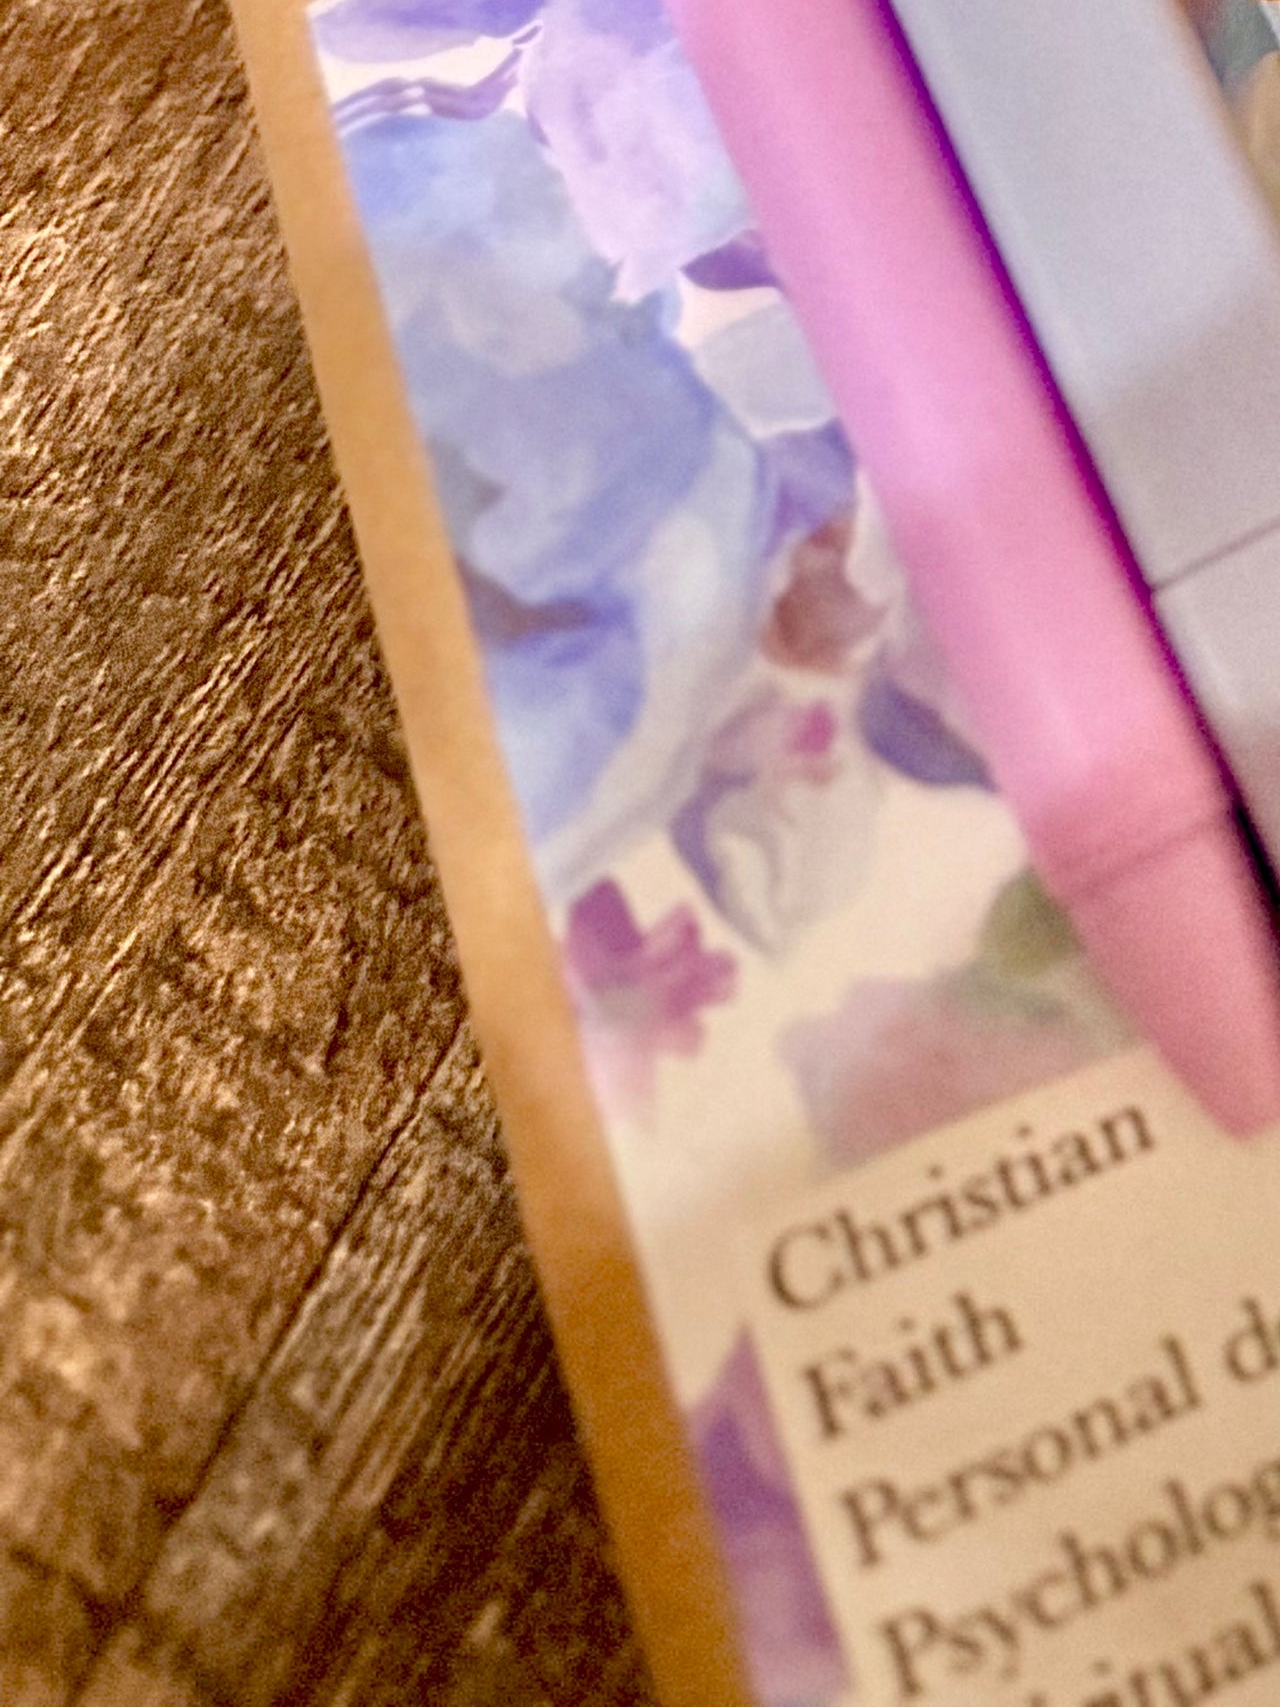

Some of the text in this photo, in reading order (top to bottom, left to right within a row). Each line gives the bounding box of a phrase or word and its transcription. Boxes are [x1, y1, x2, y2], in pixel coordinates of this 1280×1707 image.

[767, 1104, 1156, 1313] Christian
[803, 1290, 1024, 1442] Faith
[839, 1334, 1203, 1569] Personal
